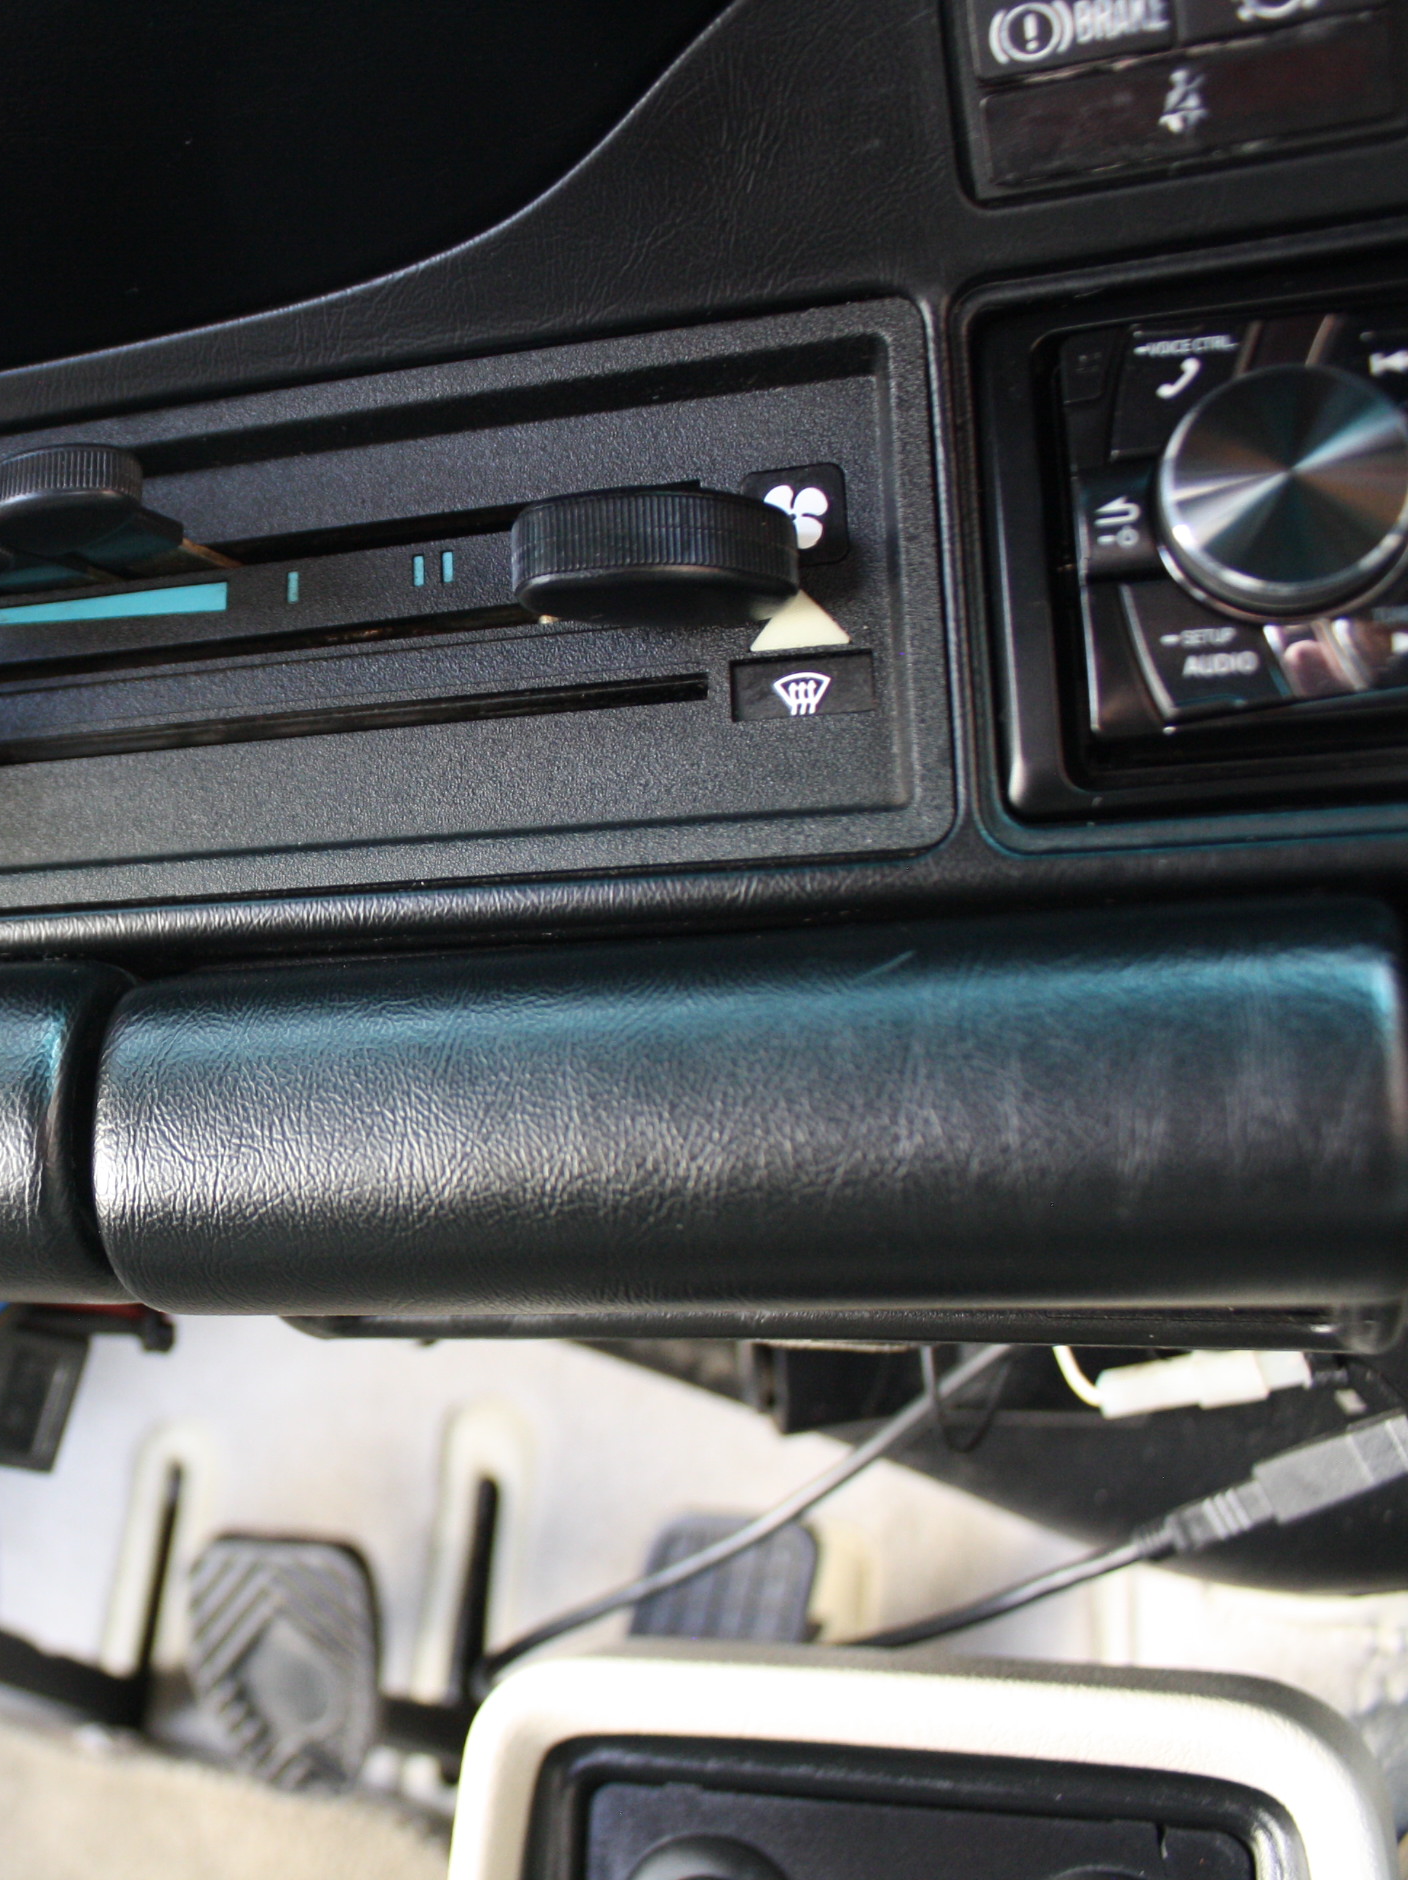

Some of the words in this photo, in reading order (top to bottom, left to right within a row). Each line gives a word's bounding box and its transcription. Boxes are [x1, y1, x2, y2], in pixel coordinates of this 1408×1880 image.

[1074, 0, 1169, 43] BRAKE
[1180, 627, 1236, 648] SETUP
[1182, 651, 1259, 677] AUDIO
